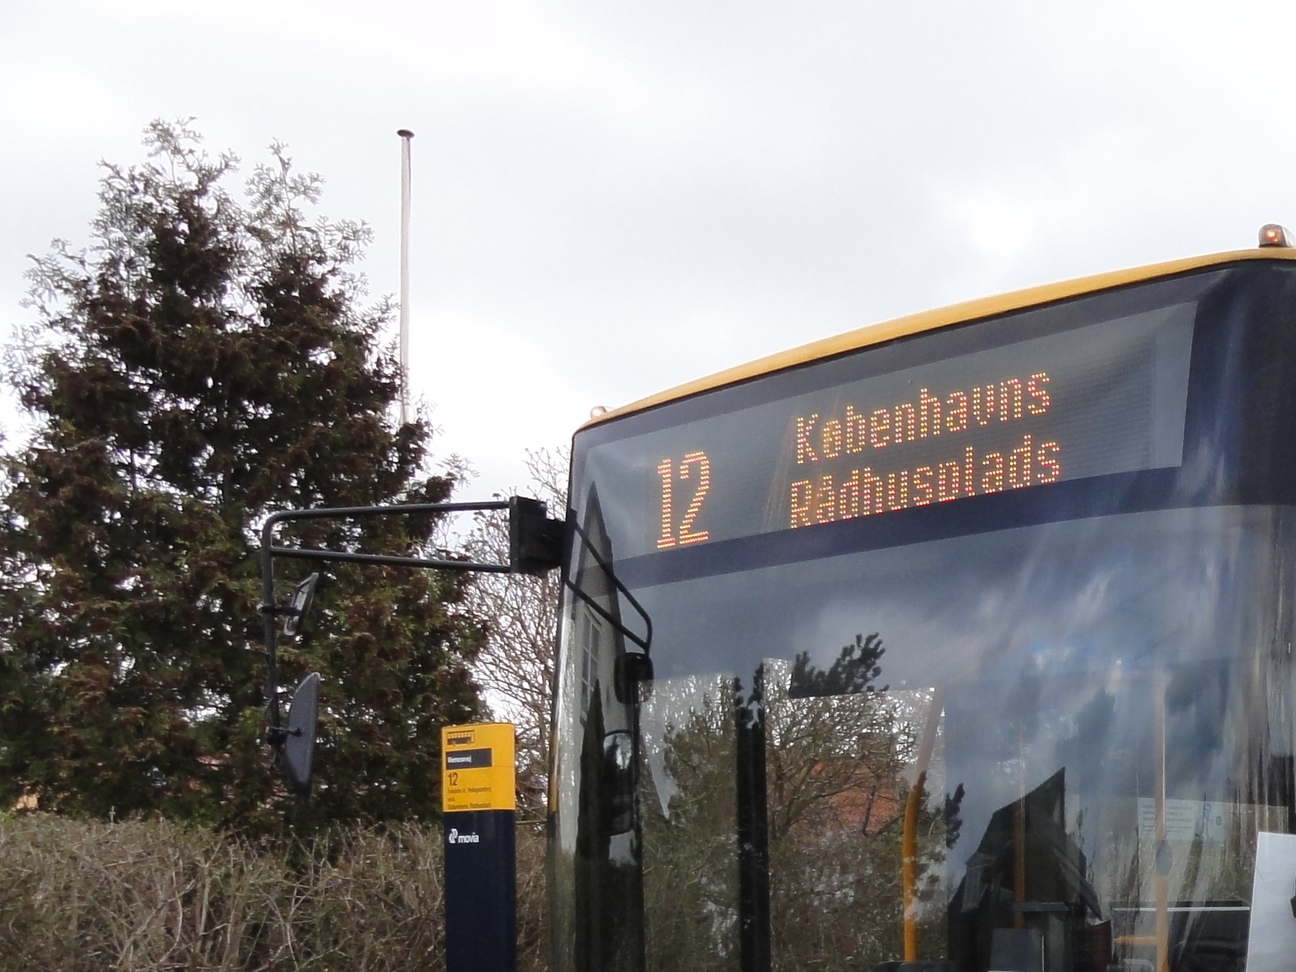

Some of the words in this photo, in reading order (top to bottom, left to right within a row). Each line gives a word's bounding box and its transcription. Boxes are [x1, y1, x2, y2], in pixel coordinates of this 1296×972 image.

[796, 372, 1051, 465] Københavns
[657, 450, 711, 548] 12
[790, 434, 1061, 529] Rådhusplads
[448, 772, 458, 786] 12
[458, 832, 479, 843] movia
